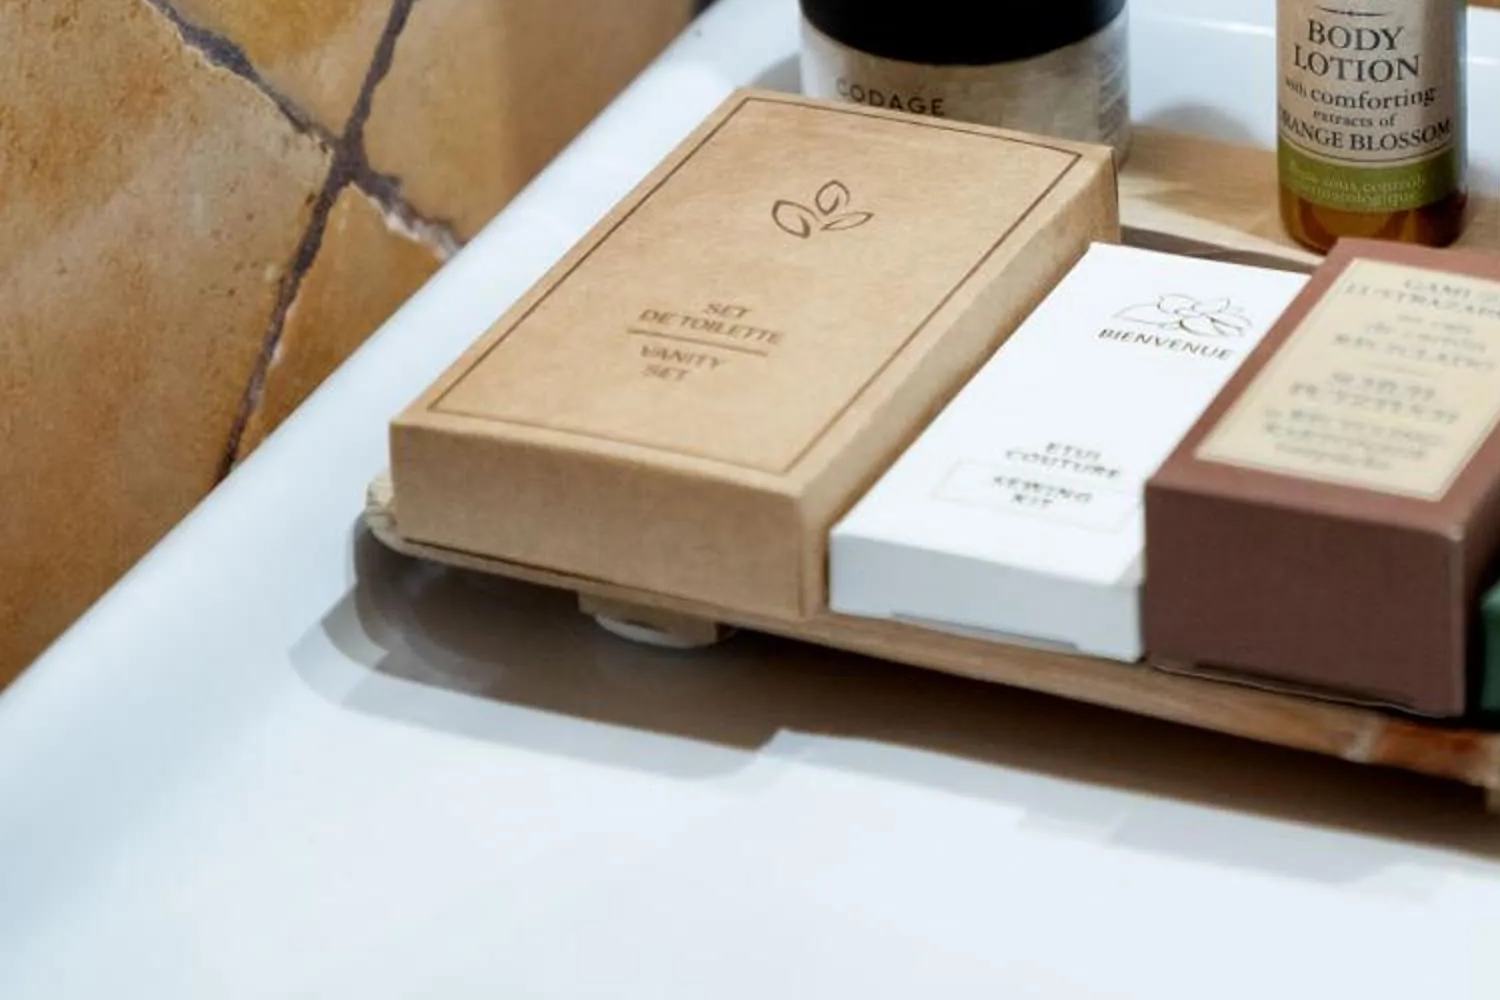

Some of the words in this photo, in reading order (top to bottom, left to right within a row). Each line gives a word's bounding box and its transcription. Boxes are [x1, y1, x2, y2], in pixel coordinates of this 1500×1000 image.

[1307, 19, 1404, 51] BODY
[1294, 45, 1420, 83] LOTION
[835, 76, 946, 117] CODAGE
[1311, 86, 1437, 110] comforting
[1279, 107, 1343, 149] RANGE
[1350, 118, 1450, 151] BLOSSOM
[1313, 109, 1373, 128] extracts
[1379, 115, 1397, 128] of
[704, 302, 750, 319] SET
[1098, 328, 1234, 360] BIENVENUE
